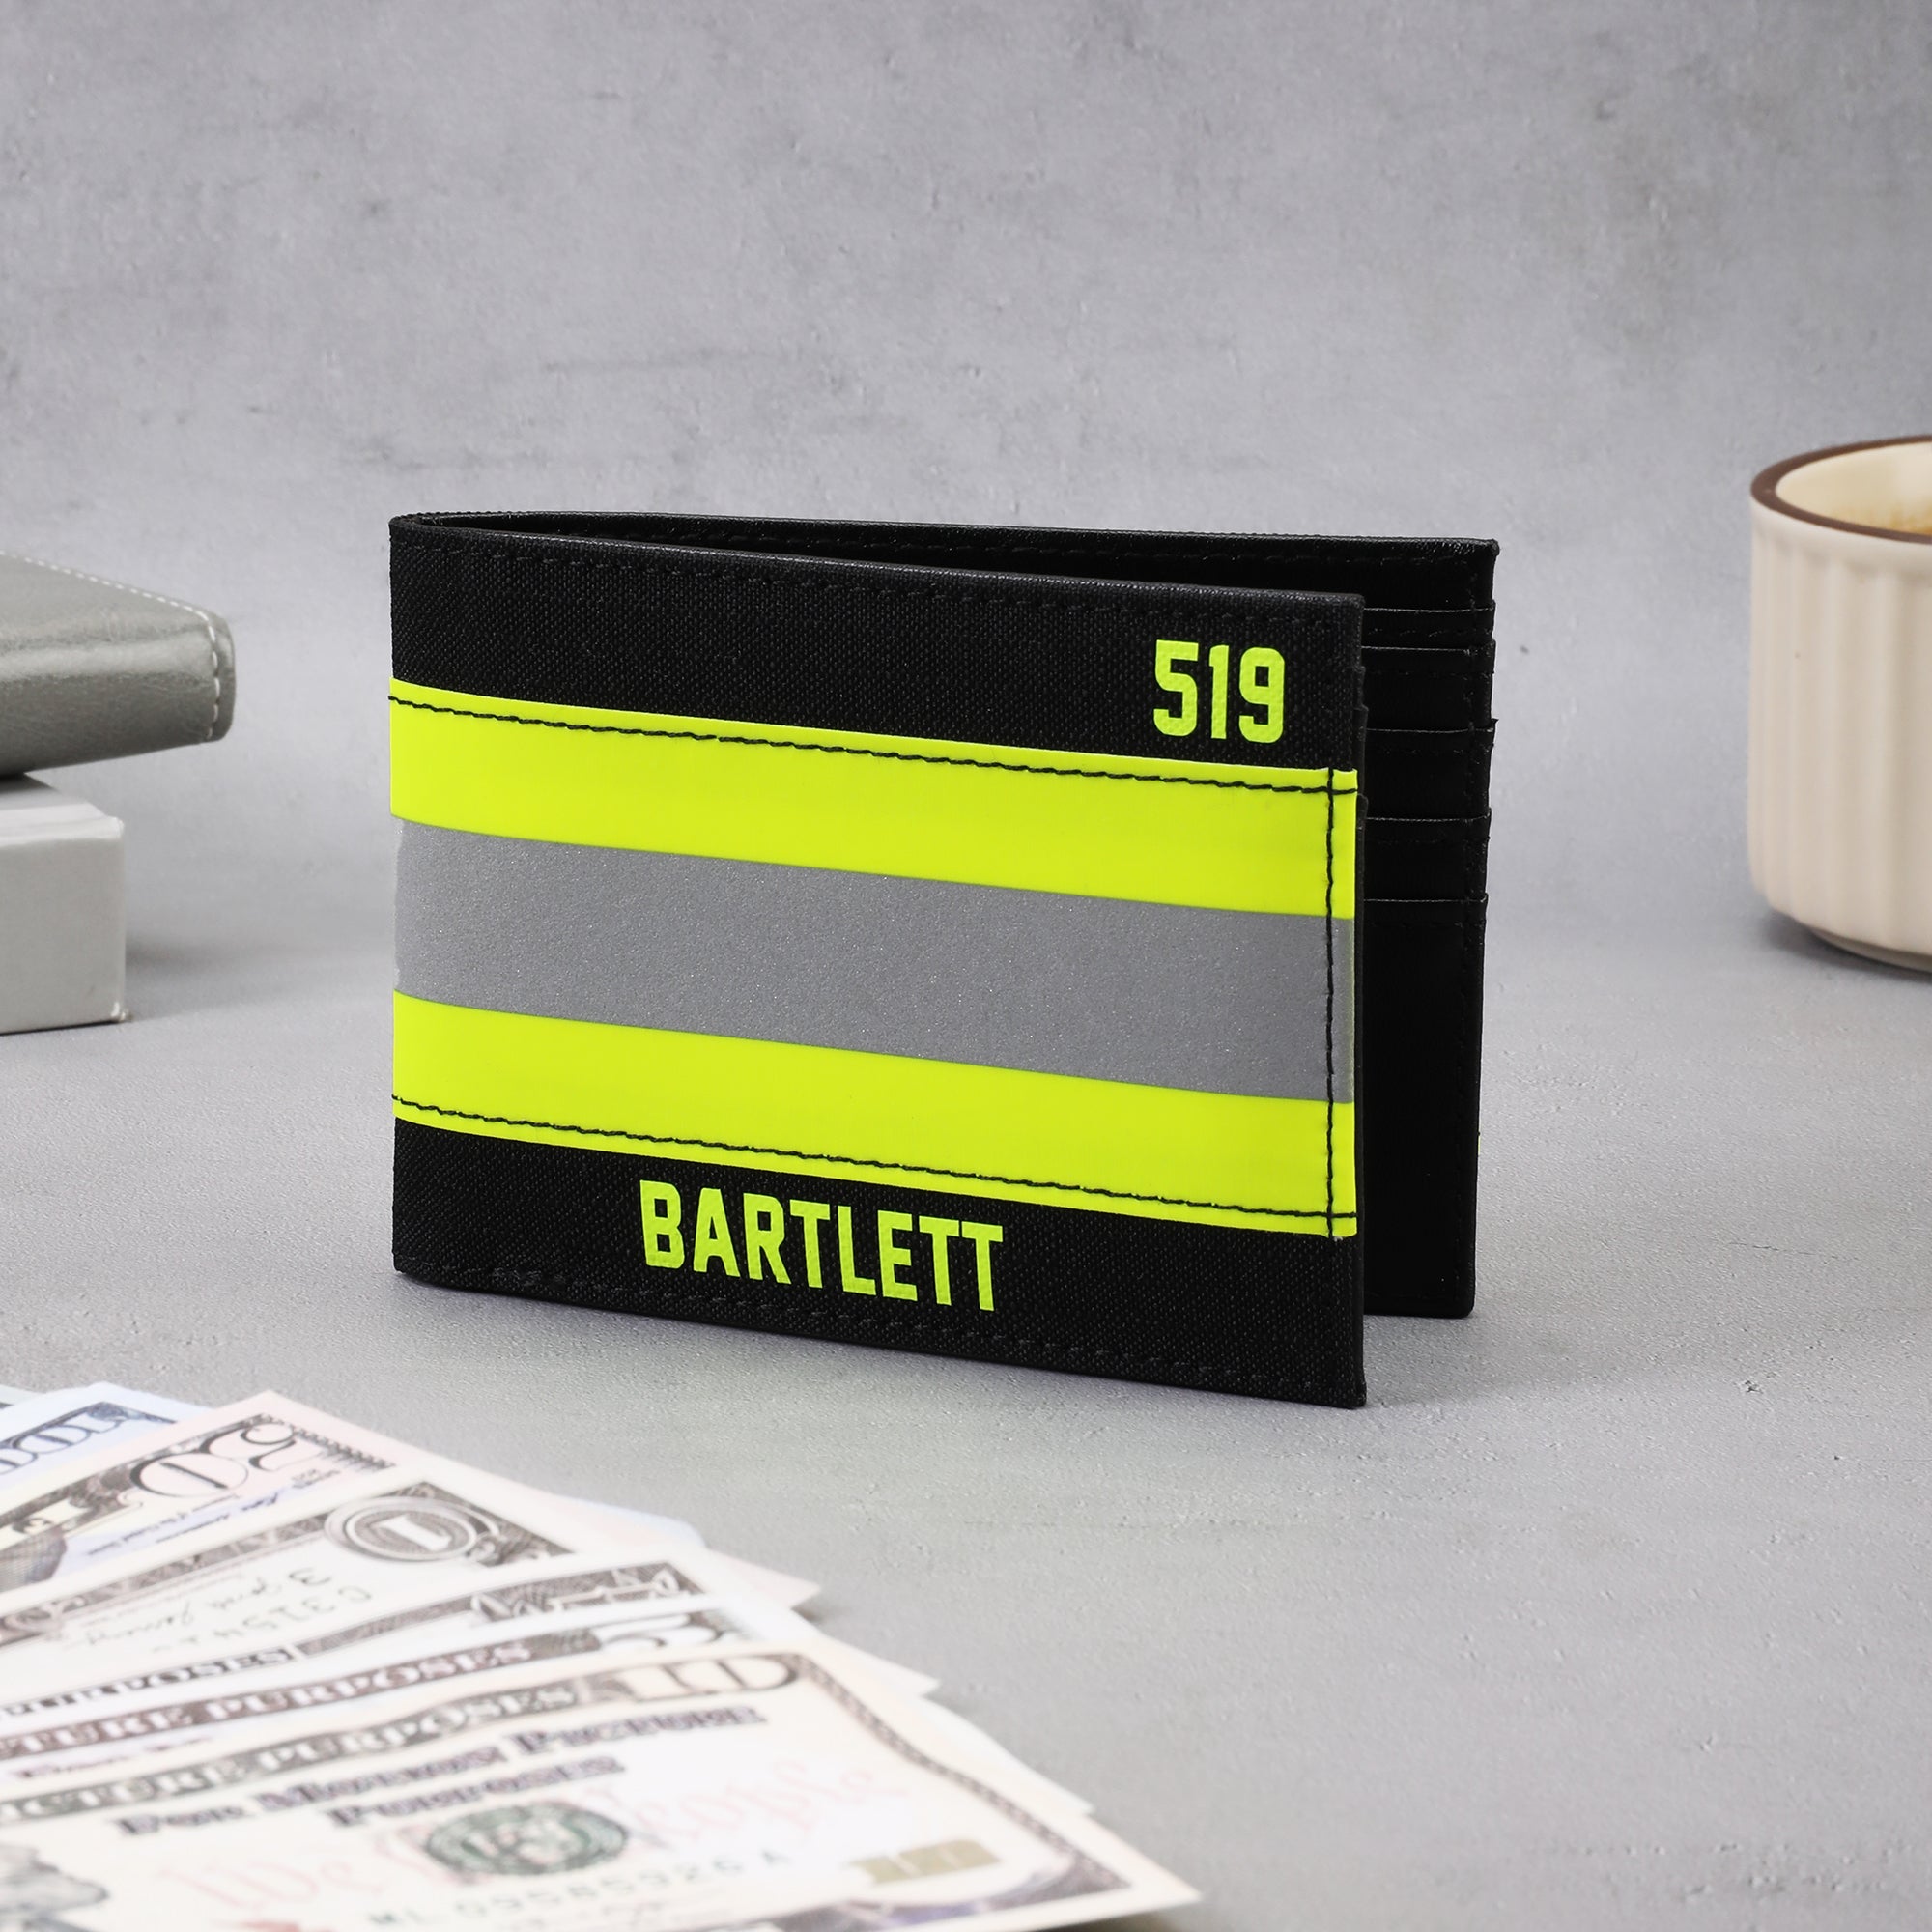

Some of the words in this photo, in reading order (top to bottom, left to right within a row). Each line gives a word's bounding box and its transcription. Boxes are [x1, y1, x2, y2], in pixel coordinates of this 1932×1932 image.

[1153, 639, 1286, 744] 519
[639, 1179, 1004, 1312] BARTLETT
[205, 1640, 533, 1720] PURPOSES
[257, 1686, 578, 1771] PURPOSES
